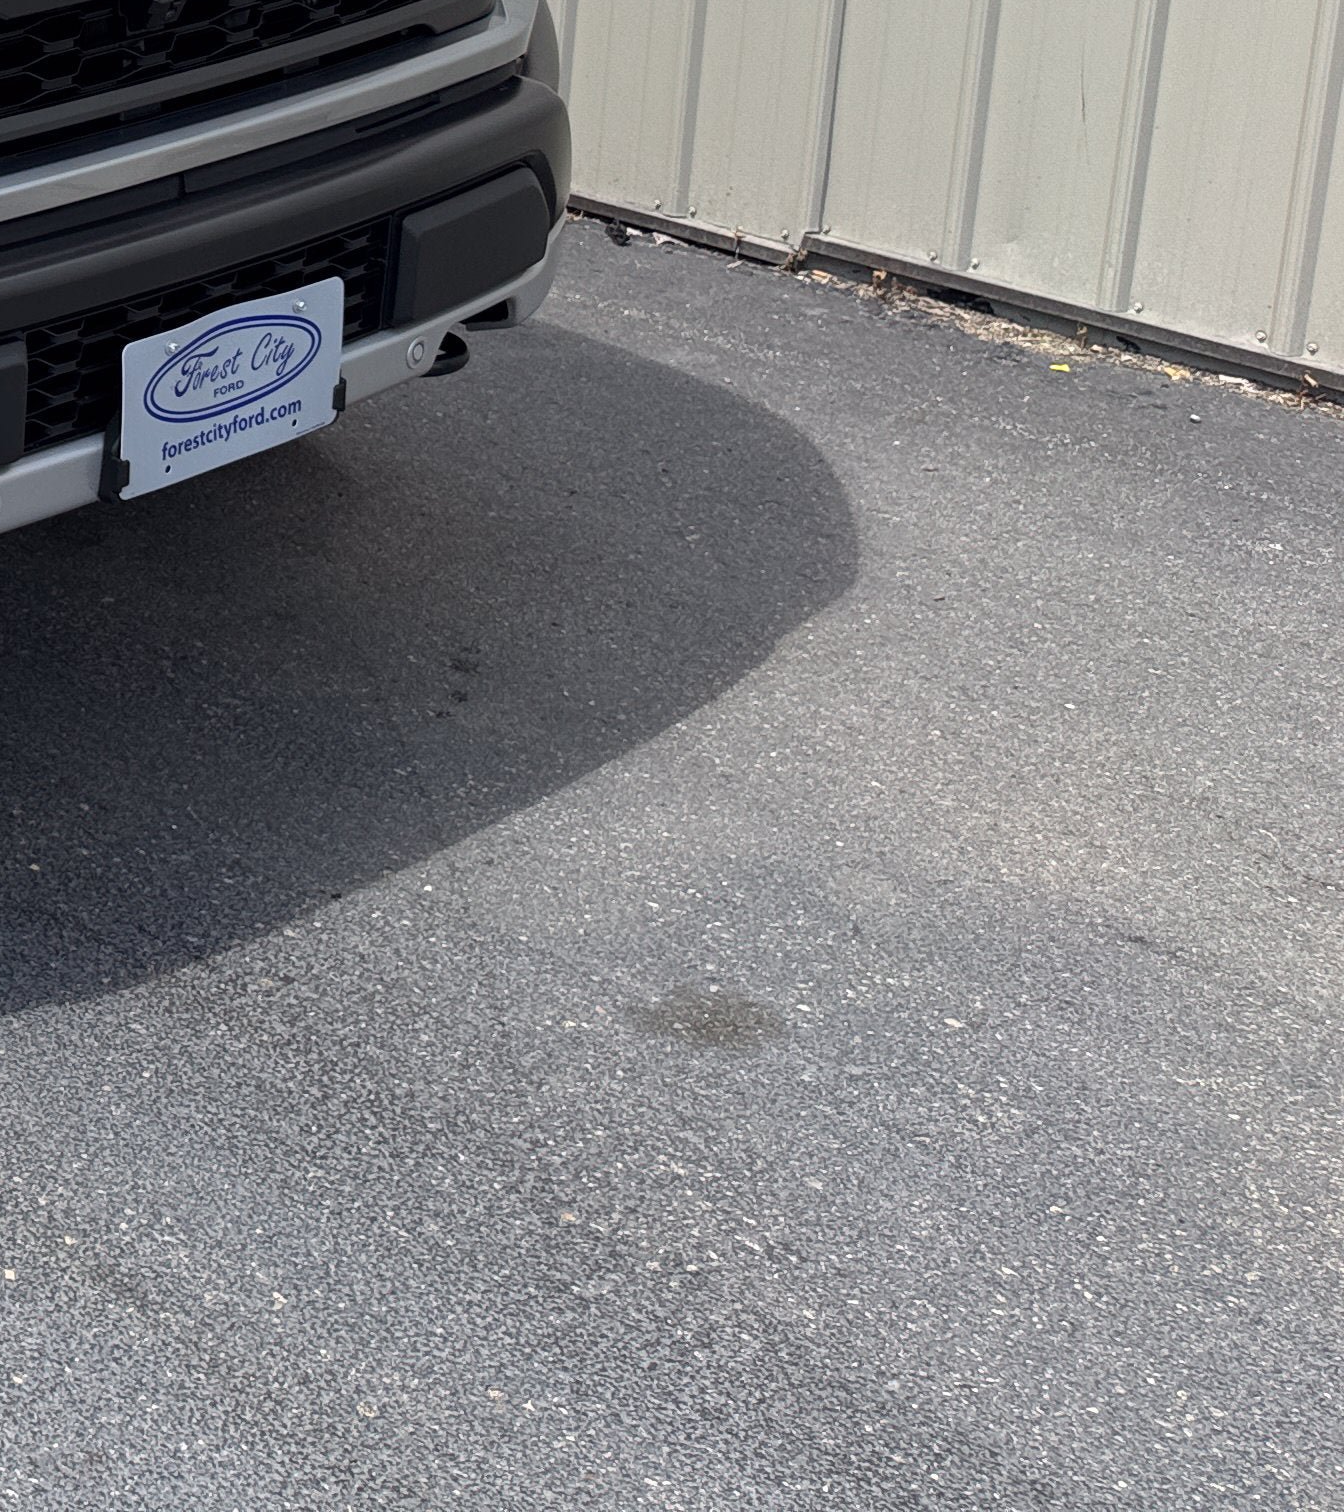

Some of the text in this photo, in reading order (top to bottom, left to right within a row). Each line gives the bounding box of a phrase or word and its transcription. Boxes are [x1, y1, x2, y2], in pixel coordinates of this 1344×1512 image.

[174, 332, 295, 398] Forest City
[213, 379, 245, 398] FORD
[162, 399, 302, 461] forestcityford.com
